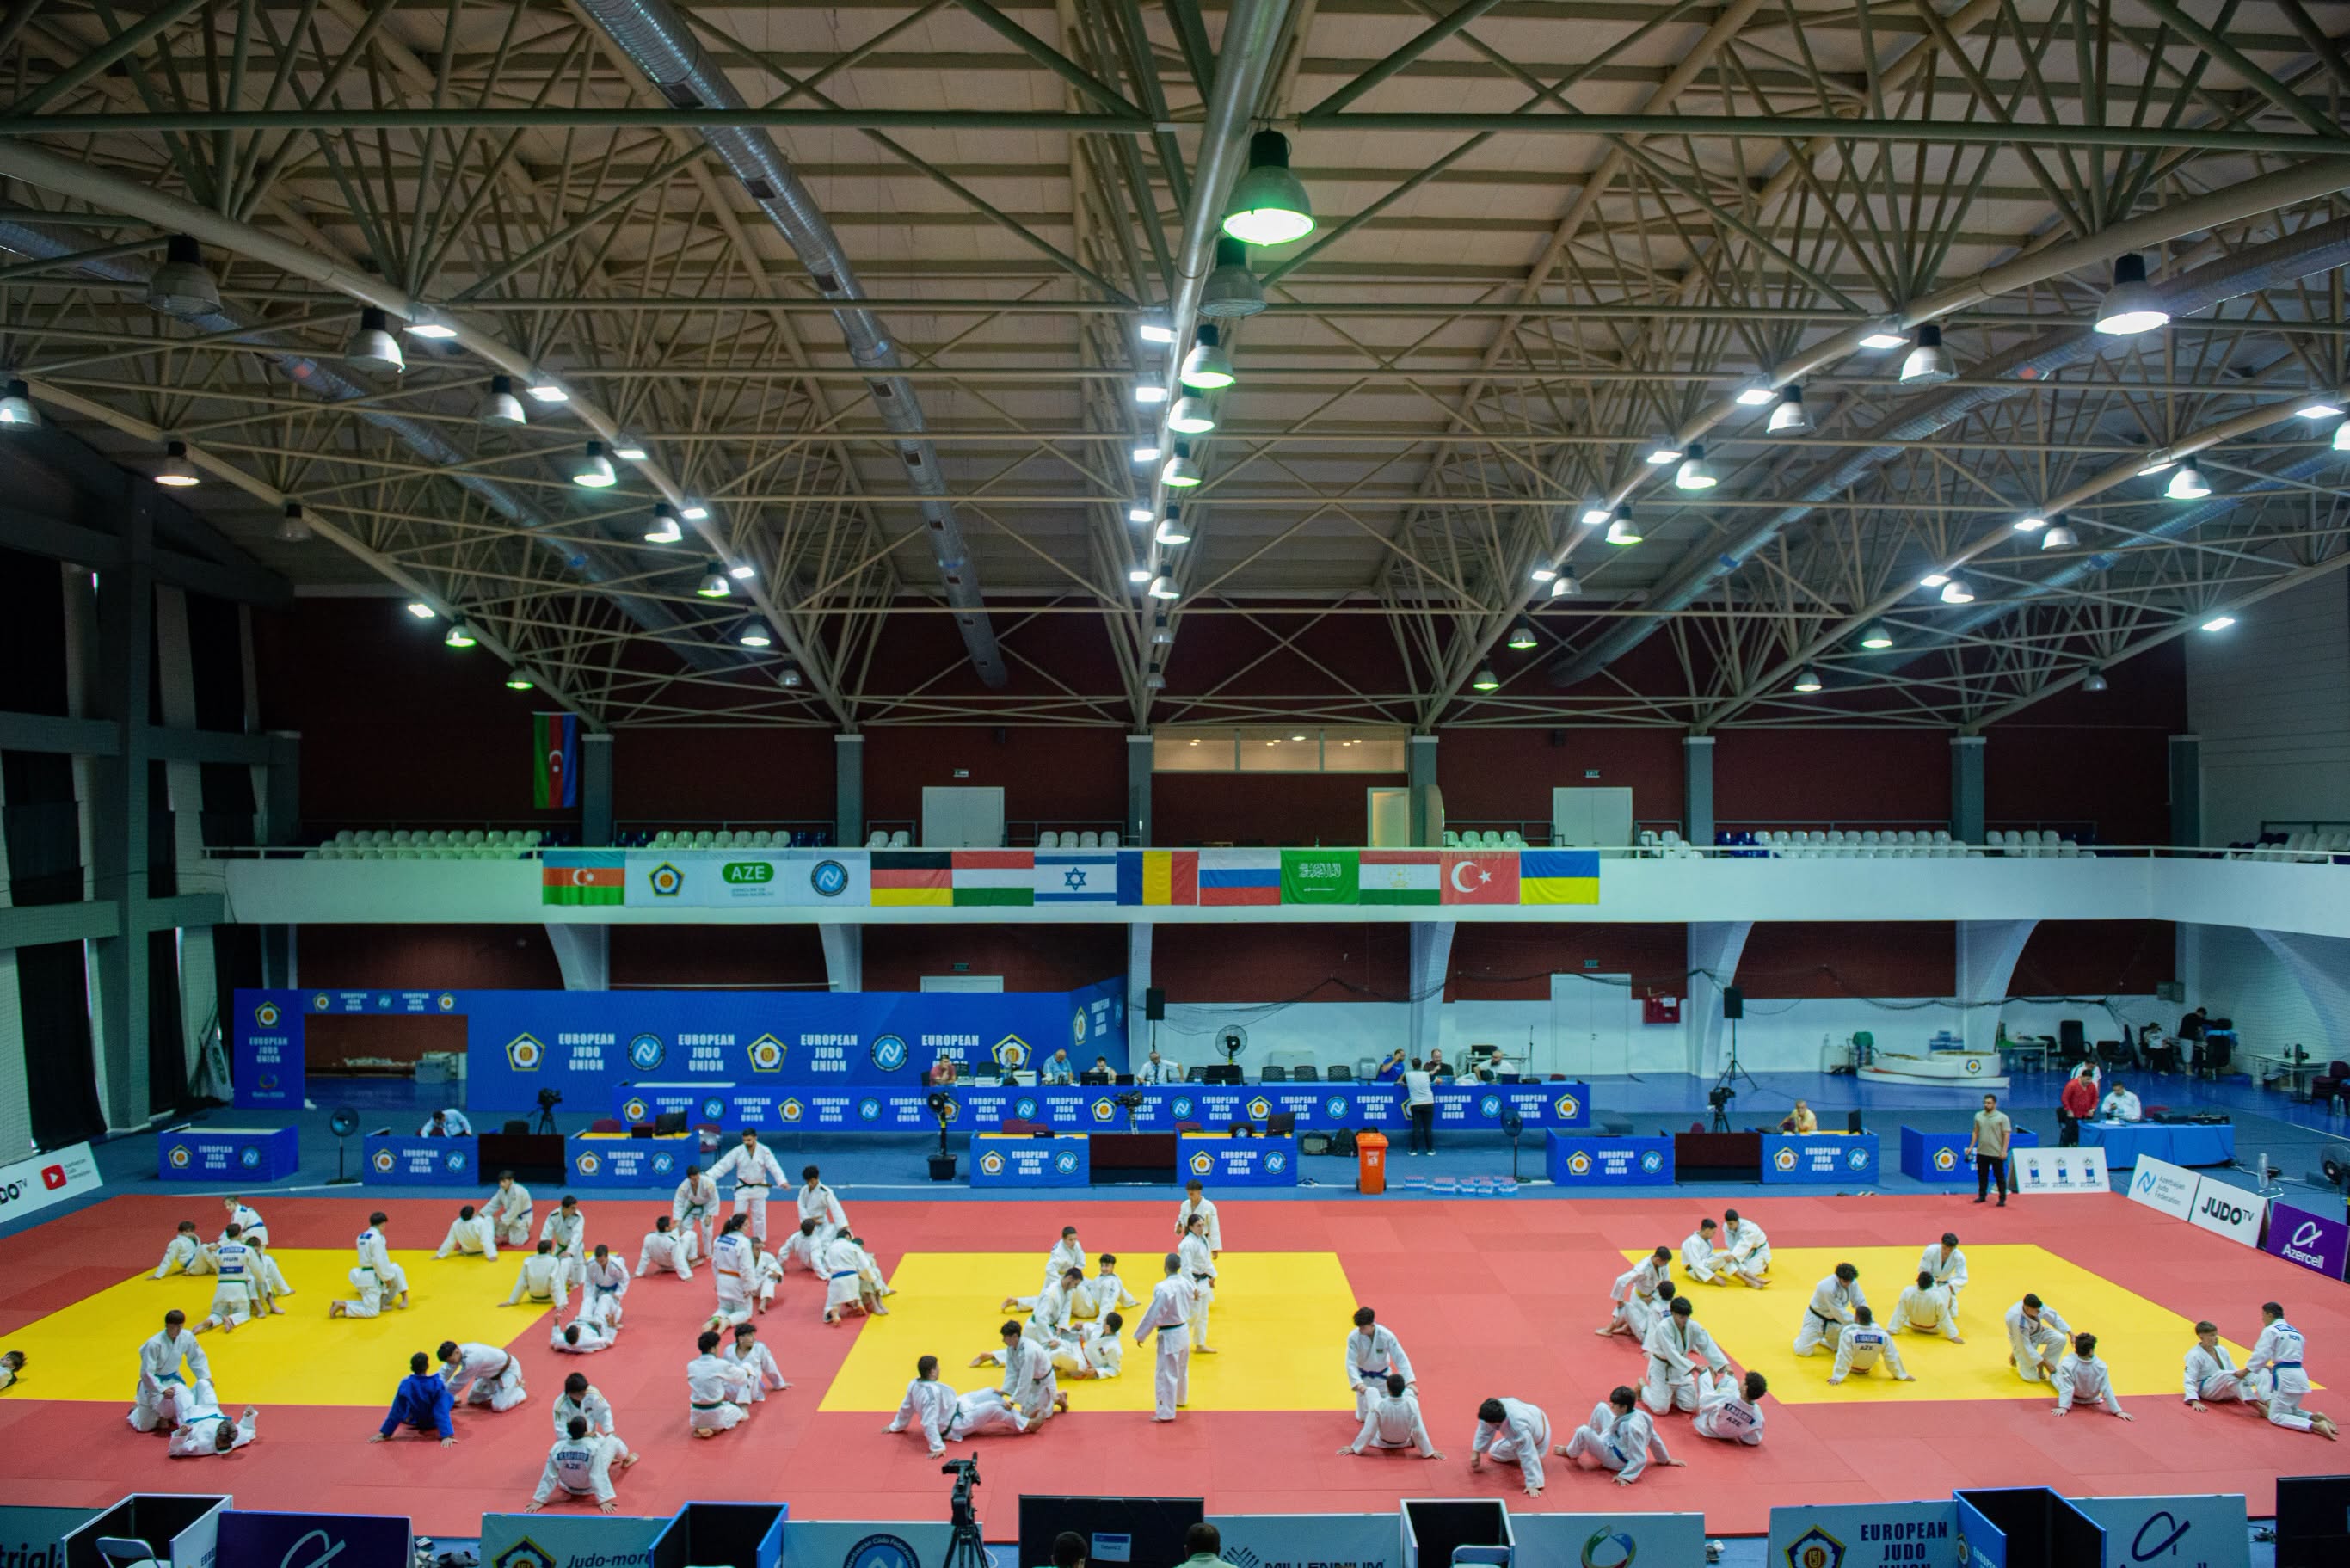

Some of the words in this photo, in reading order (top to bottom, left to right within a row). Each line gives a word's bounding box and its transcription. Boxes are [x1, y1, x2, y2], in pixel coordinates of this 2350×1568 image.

[731, 865, 765, 881] AZE
[558, 1033, 615, 1045] EUROPEAN
[678, 1034, 735, 1046] EUROPEAN
[801, 1035, 858, 1046] EUROPEAN
[921, 1035, 979, 1046] EUROPEAN
[573, 1045, 600, 1058] JUDO
[692, 1046, 720, 1059] JUDO
[815, 1046, 842, 1059] JUDO
[936, 1048, 964, 1059] JUDO
[569, 1058, 603, 1070] UNION
[689, 1059, 723, 1071] UNION
[811, 1059, 846, 1072] UNION
[2201, 1196, 2243, 1226] JUDO
[2242, 1208, 2255, 1221] TV
[2281, 1243, 2325, 1269] Azercell
[1726, 1417, 1741, 1427] AZE
[1861, 1522, 1947, 1541] EUROPEAN
[1883, 1543, 1926, 1561] JUDO
